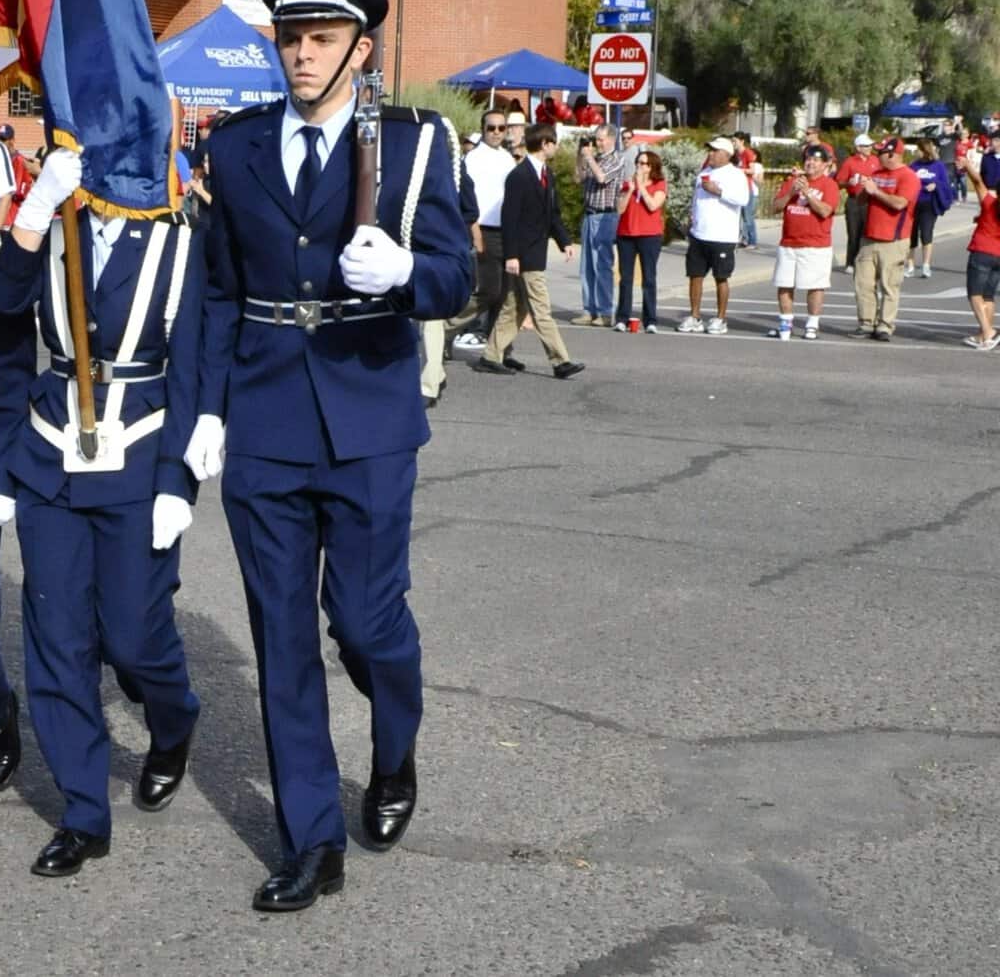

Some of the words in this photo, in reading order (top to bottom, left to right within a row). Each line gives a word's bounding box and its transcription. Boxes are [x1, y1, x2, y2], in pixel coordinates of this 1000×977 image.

[600, 48, 615, 59] DO
[620, 48, 641, 59] NOT
[602, 78, 635, 90] ENTER
[176, 86, 190, 96] THE
[192, 87, 233, 96] UNIVERSITY
[240, 91, 259, 102] SELL
